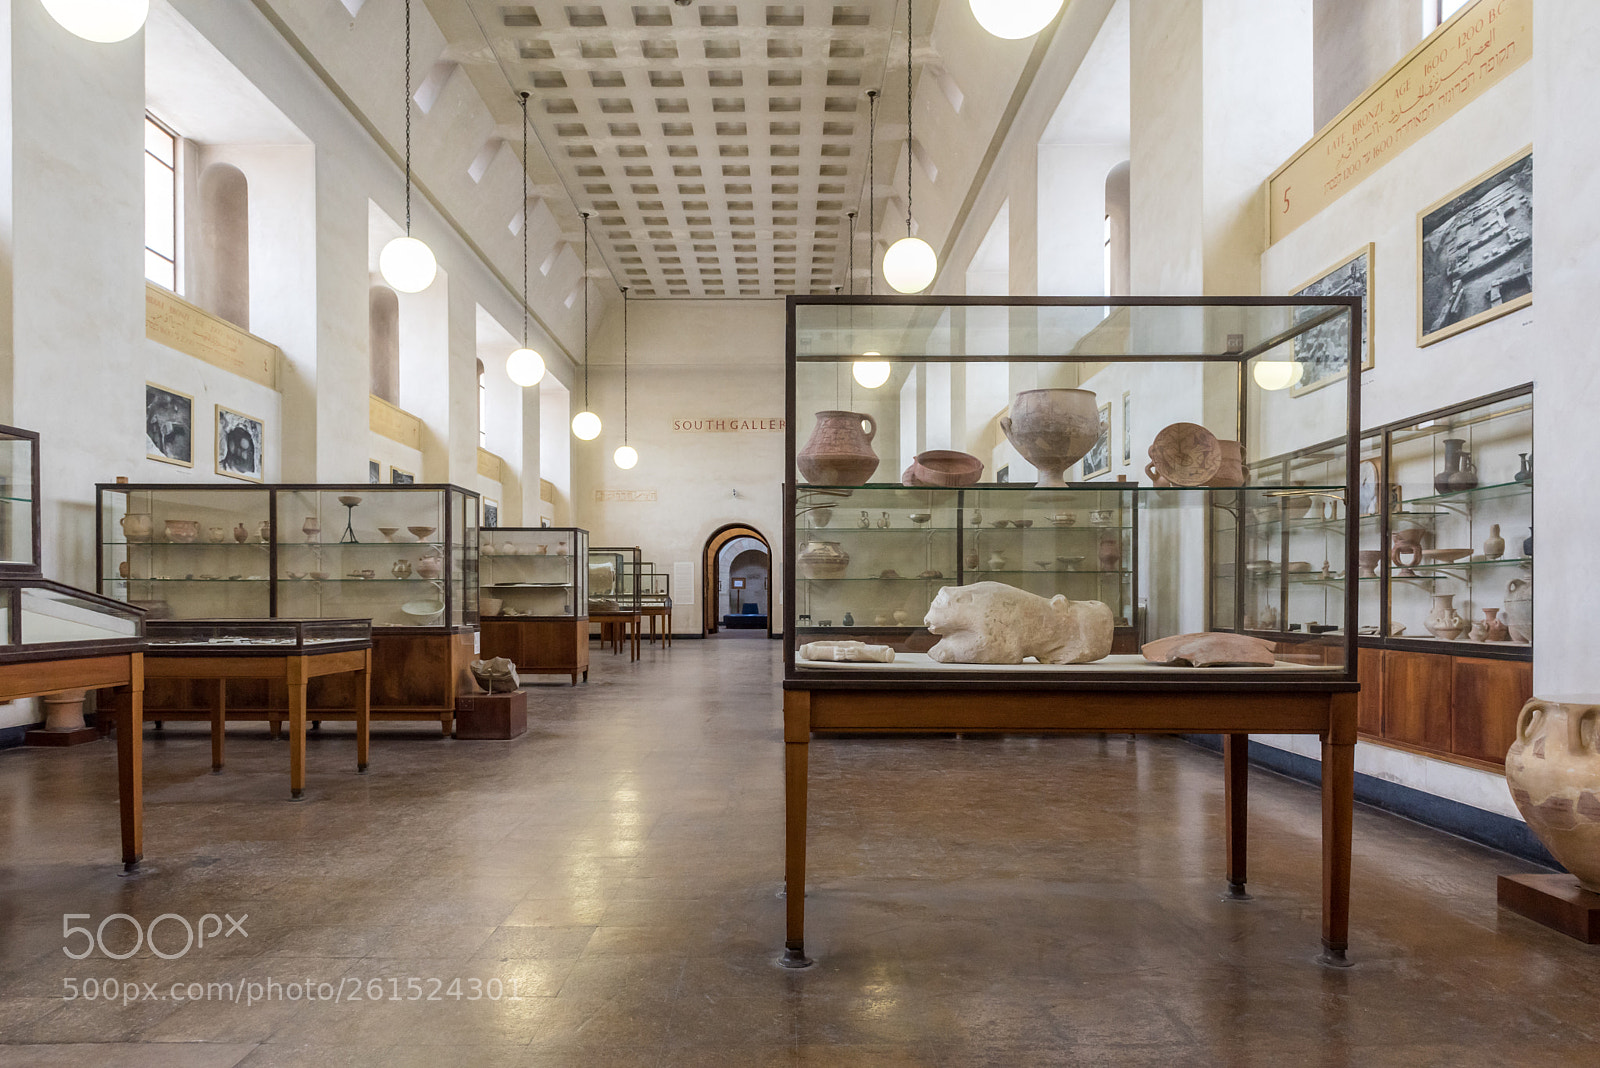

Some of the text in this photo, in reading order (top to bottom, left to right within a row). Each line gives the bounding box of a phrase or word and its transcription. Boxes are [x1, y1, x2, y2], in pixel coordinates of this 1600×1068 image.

[1352, 100, 1385, 135] BRONZE
[1394, 78, 1412, 99] AGE
[1424, 48, 1448, 77] 1600
[1458, 18, 1484, 48] 1200
[1283, 186, 1291, 214] 5
[674, 420, 786, 431] SOUTH GALLER
